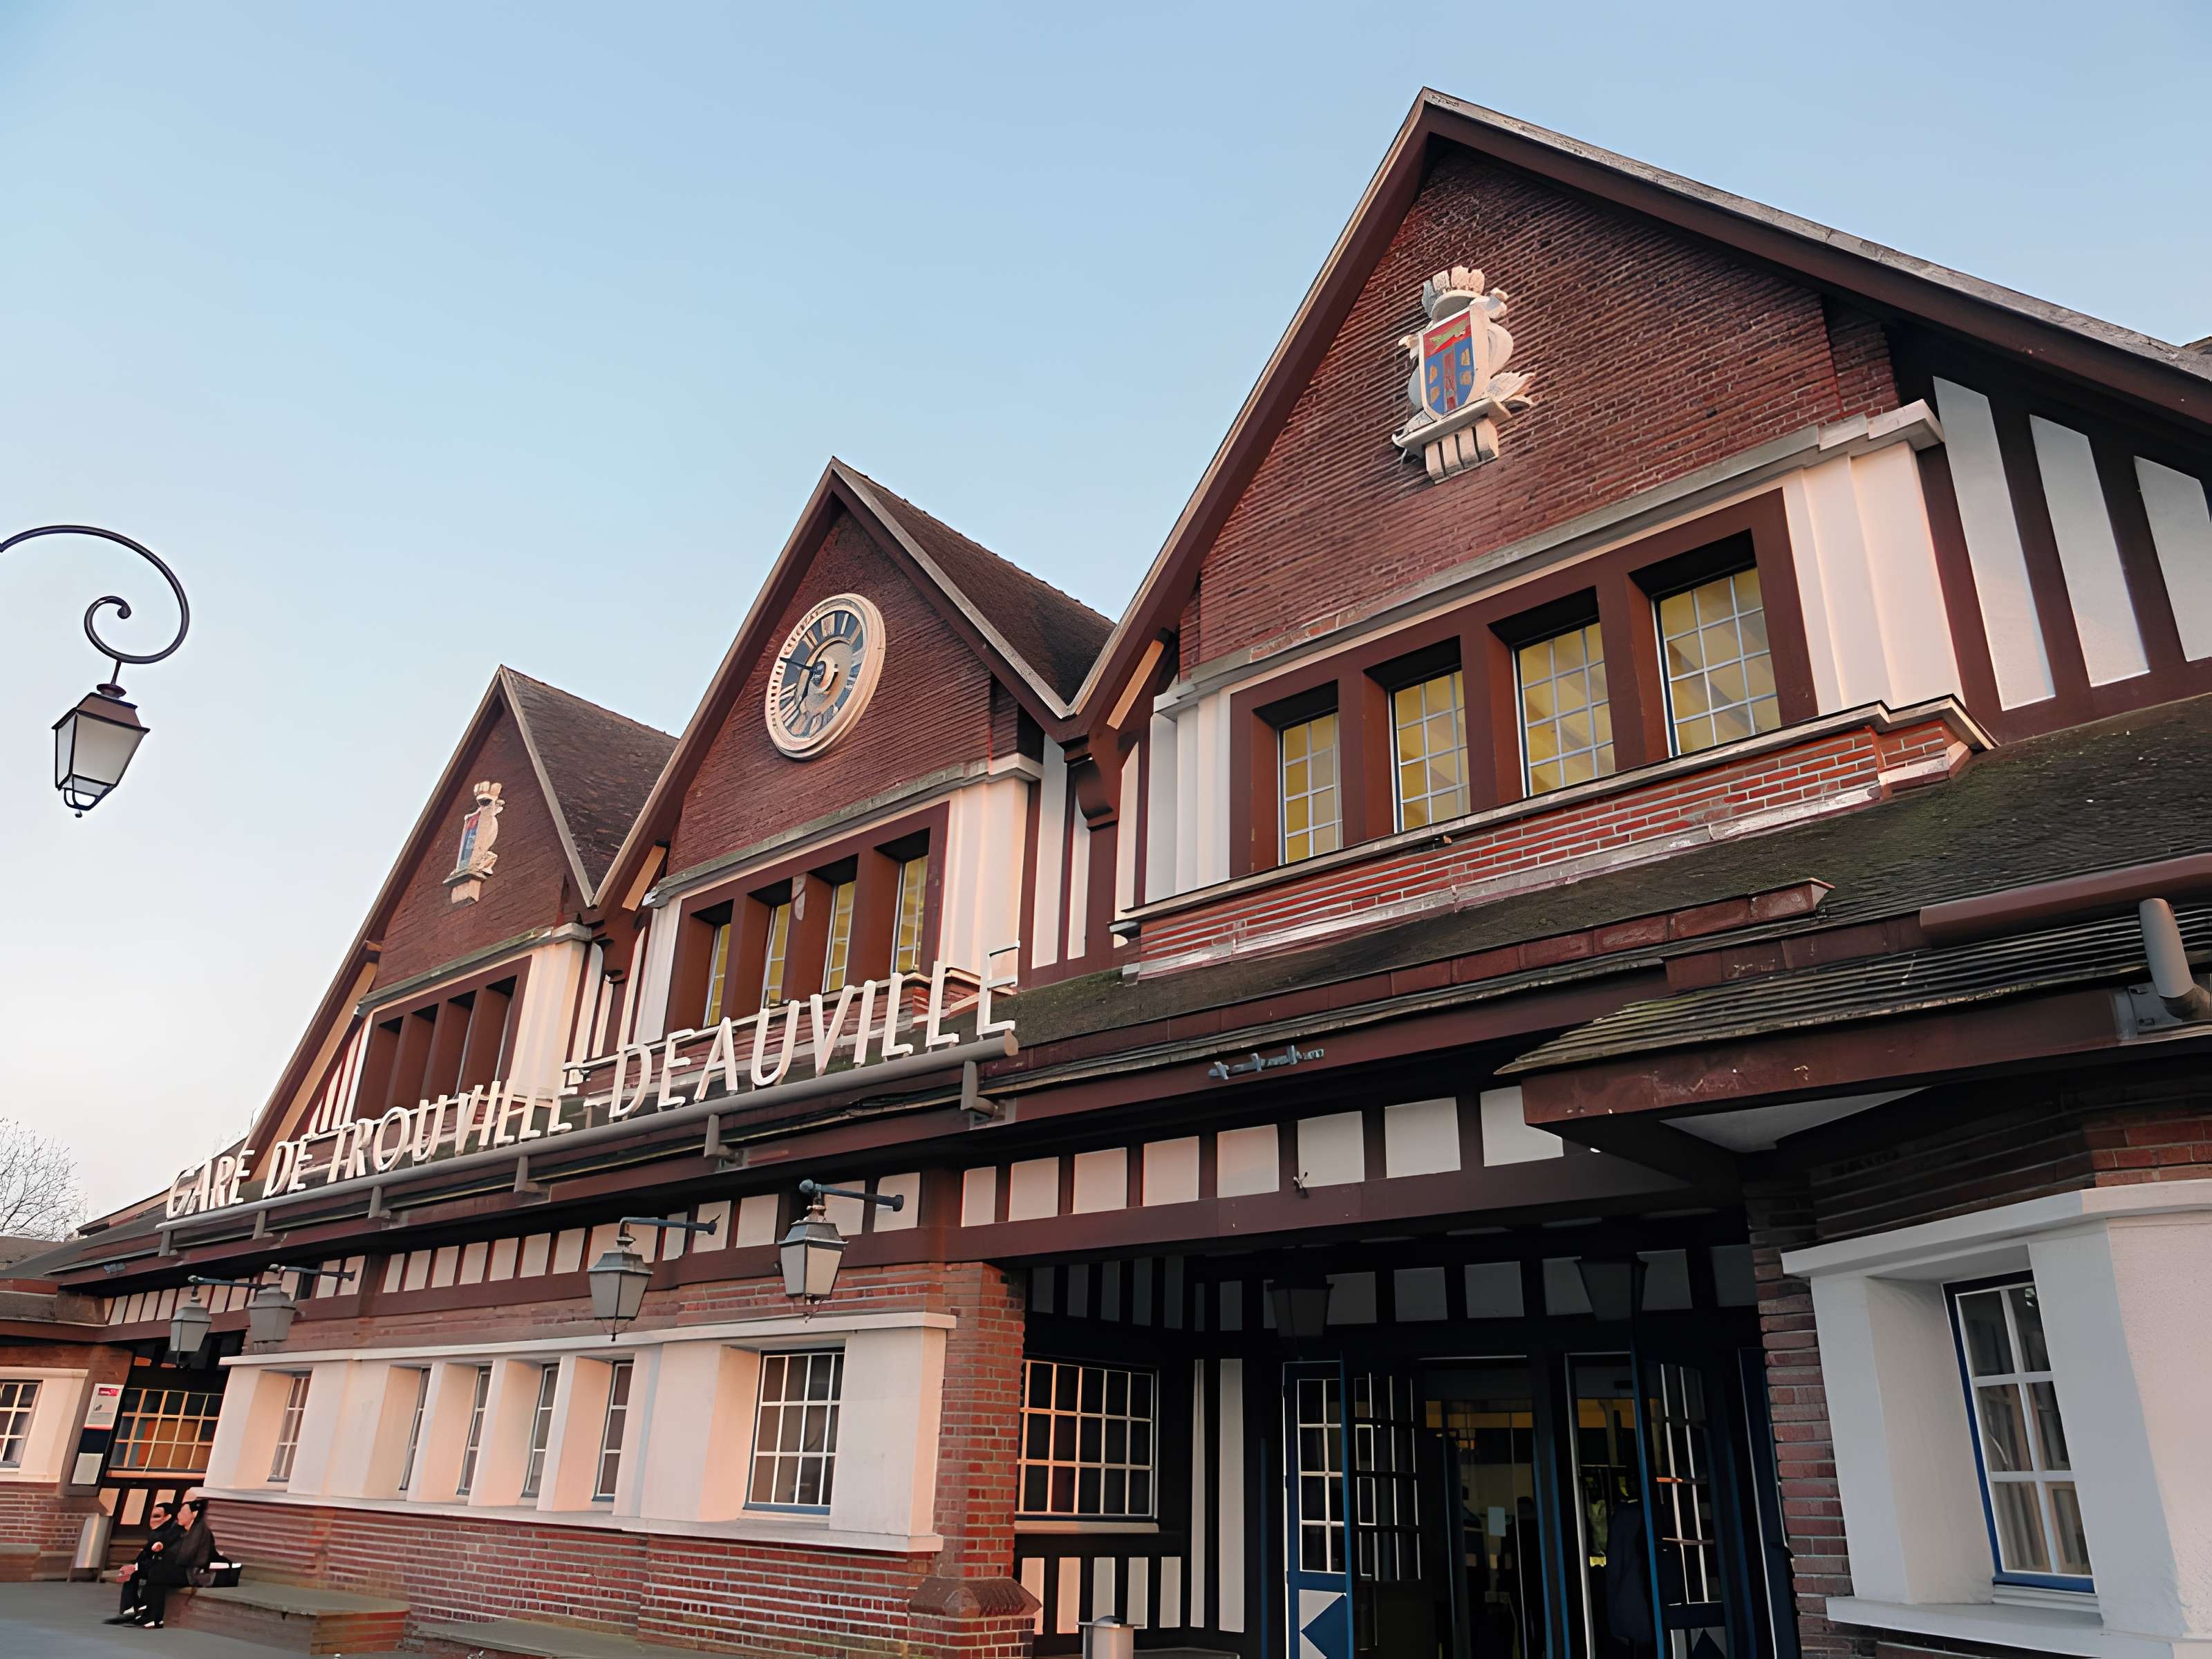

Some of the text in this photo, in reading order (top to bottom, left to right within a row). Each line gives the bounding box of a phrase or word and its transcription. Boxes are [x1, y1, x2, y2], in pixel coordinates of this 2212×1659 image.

[166, 1150, 255, 1221] GARE
[263, 1134, 315, 1199] DE
[326, 1060, 579, 1183] TROUVILLE
[608, 940, 1020, 1118] DEAUVILLE
